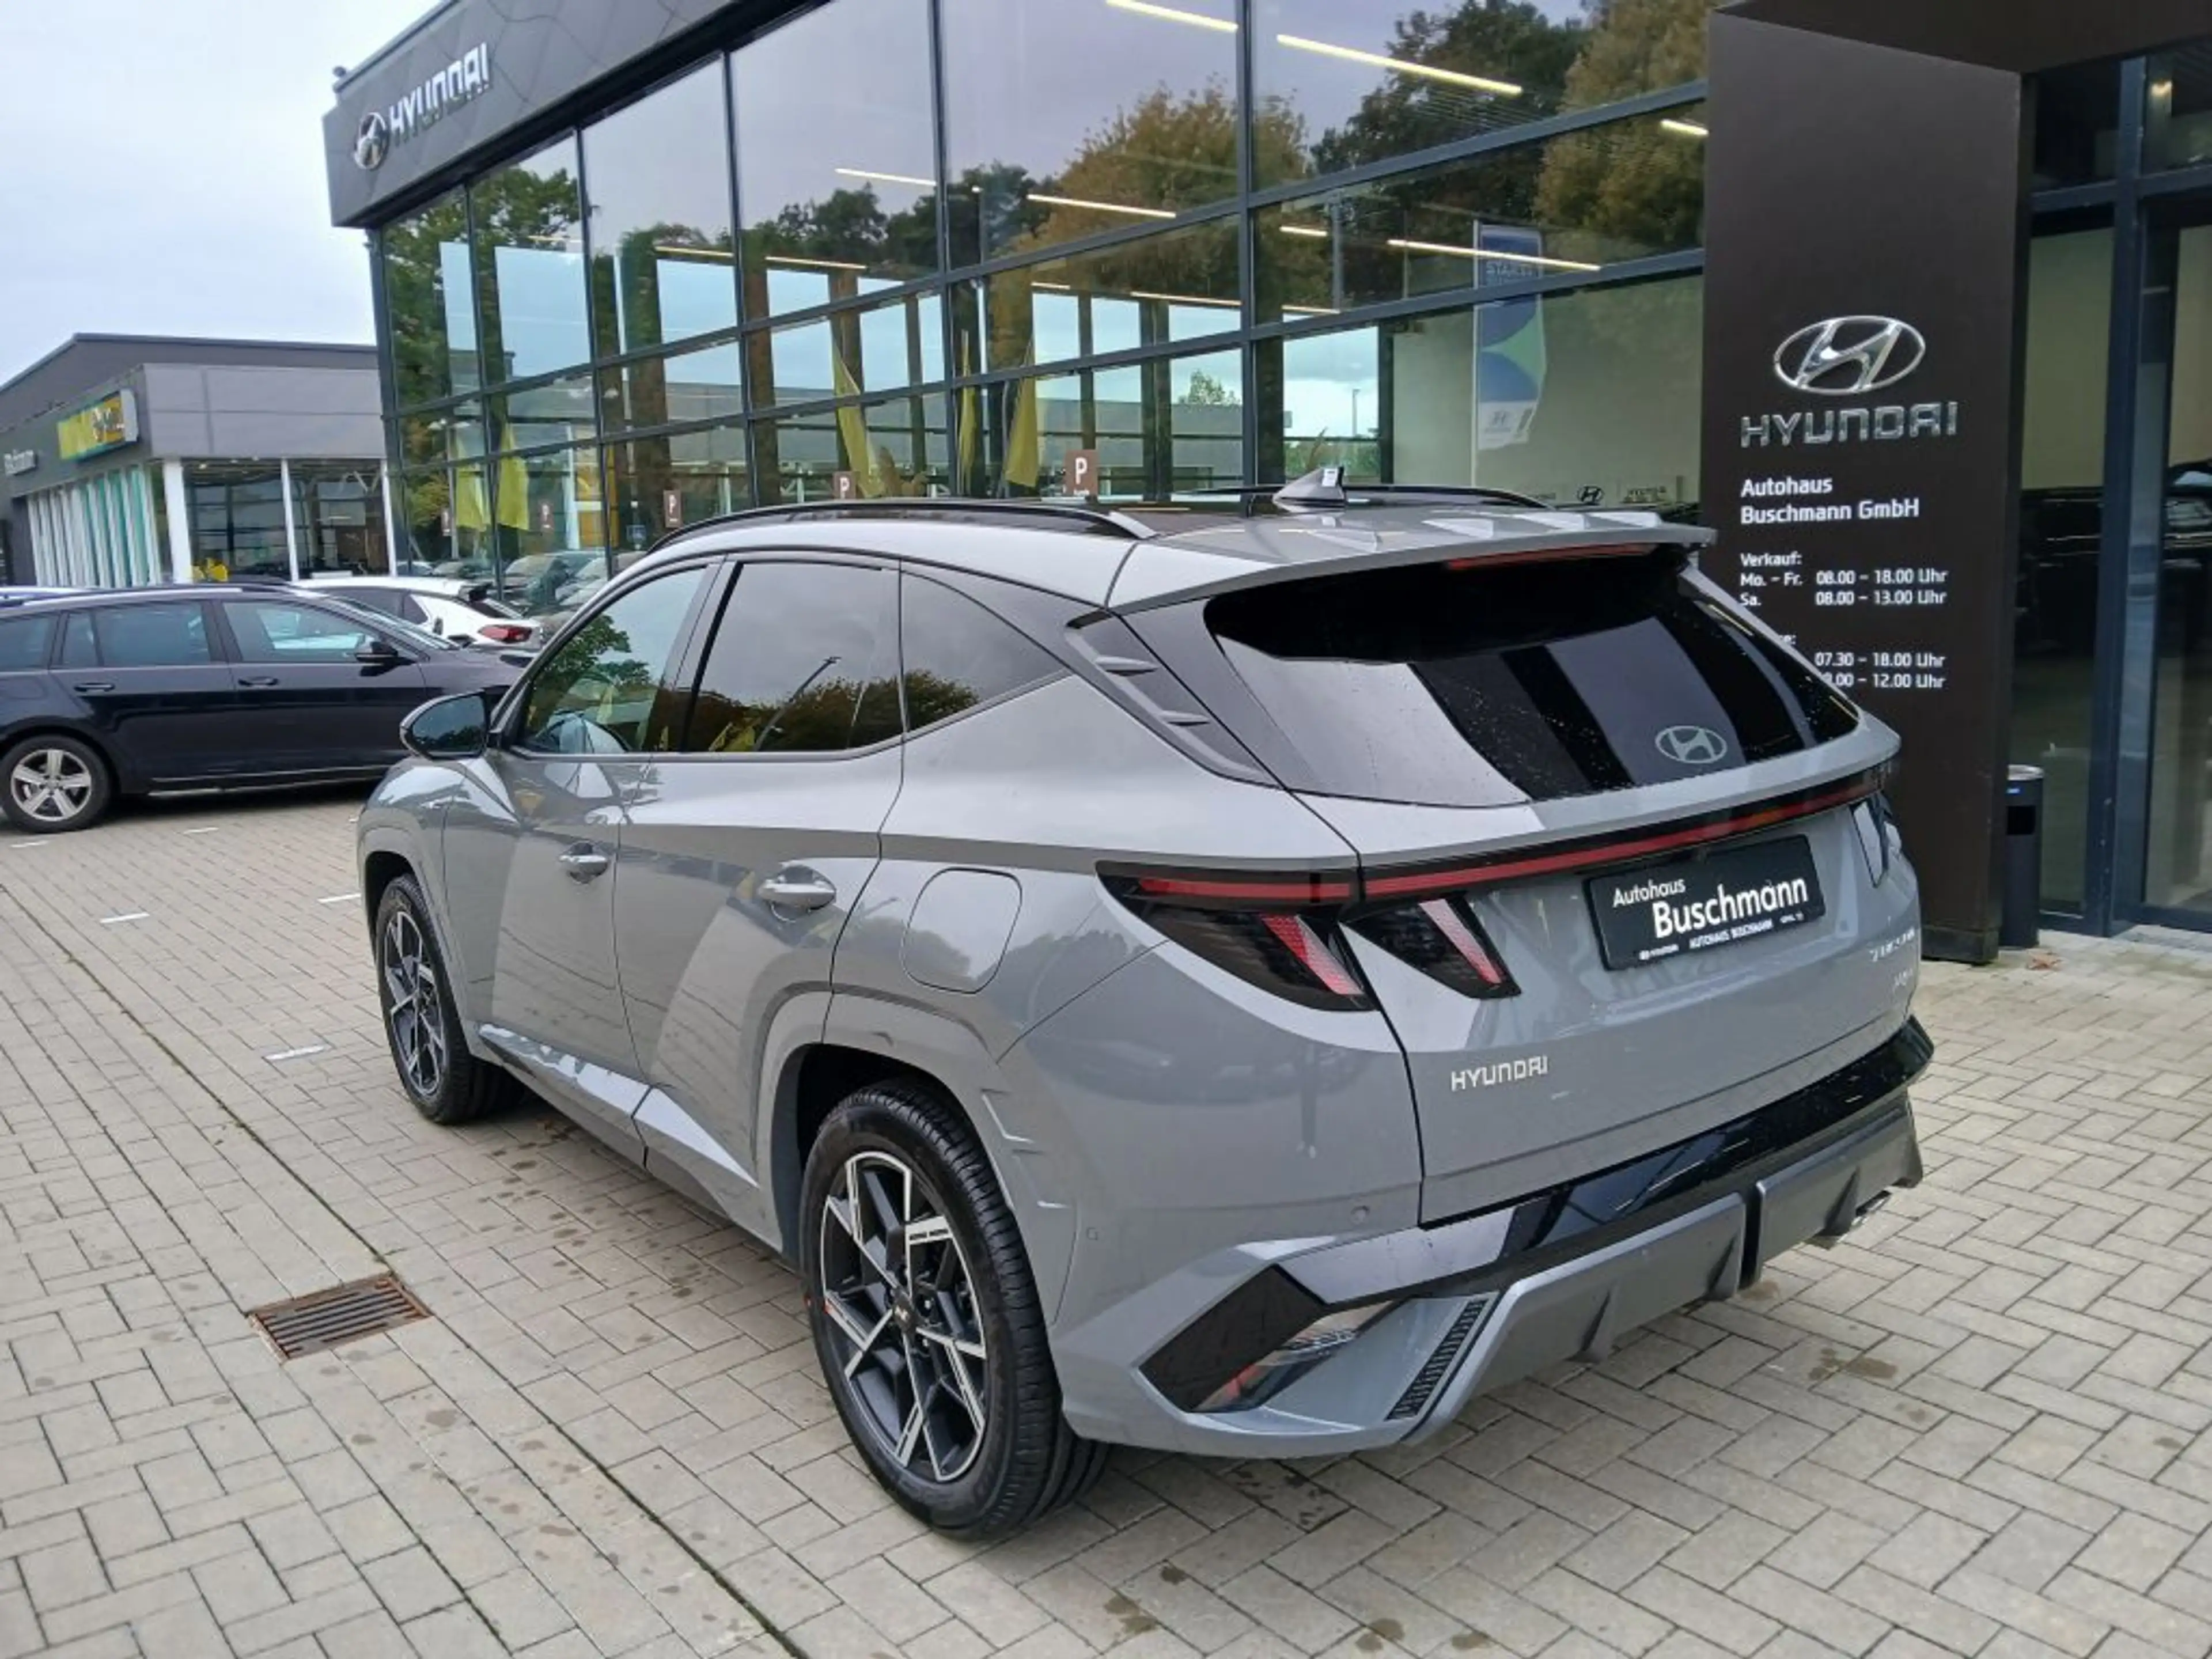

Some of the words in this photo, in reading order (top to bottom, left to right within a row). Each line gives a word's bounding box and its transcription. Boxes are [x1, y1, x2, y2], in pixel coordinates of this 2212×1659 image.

[389, 41, 489, 134] HYUNDAI
[1740, 402, 1957, 448] HYUNDAI
[1075, 457, 1088, 484] P
[1740, 476, 1833, 498] Autohaus
[1740, 502, 1852, 525] Buschmann
[1858, 497, 1920, 518] GmbH
[1740, 551, 1802, 567] Verkauf:
[1740, 573, 1767, 587] Mo.
[1784, 571, 1803, 586] Fr.
[1816, 570, 1855, 585] 08.00
[1874, 569, 1914, 584] 18.00
[1918, 568, 1948, 583] Uhr
[1740, 592, 1762, 607] Sa.
[1815, 591, 1854, 605] 08.00
[1873, 590, 1912, 605] 13.00
[1918, 589, 1948, 604] Uhr
[1815, 652, 1854, 666] 07.30
[1873, 652, 1912, 667] 18.00
[1916, 652, 1946, 667] Uhr
[1873, 673, 1911, 688] 12.00
[1915, 674, 1946, 688] Uhr
[1613, 878, 1686, 908] Autohaus
[1652, 877, 1809, 938] Buschmann
[1451, 1055, 1548, 1092] HYUNDAI
